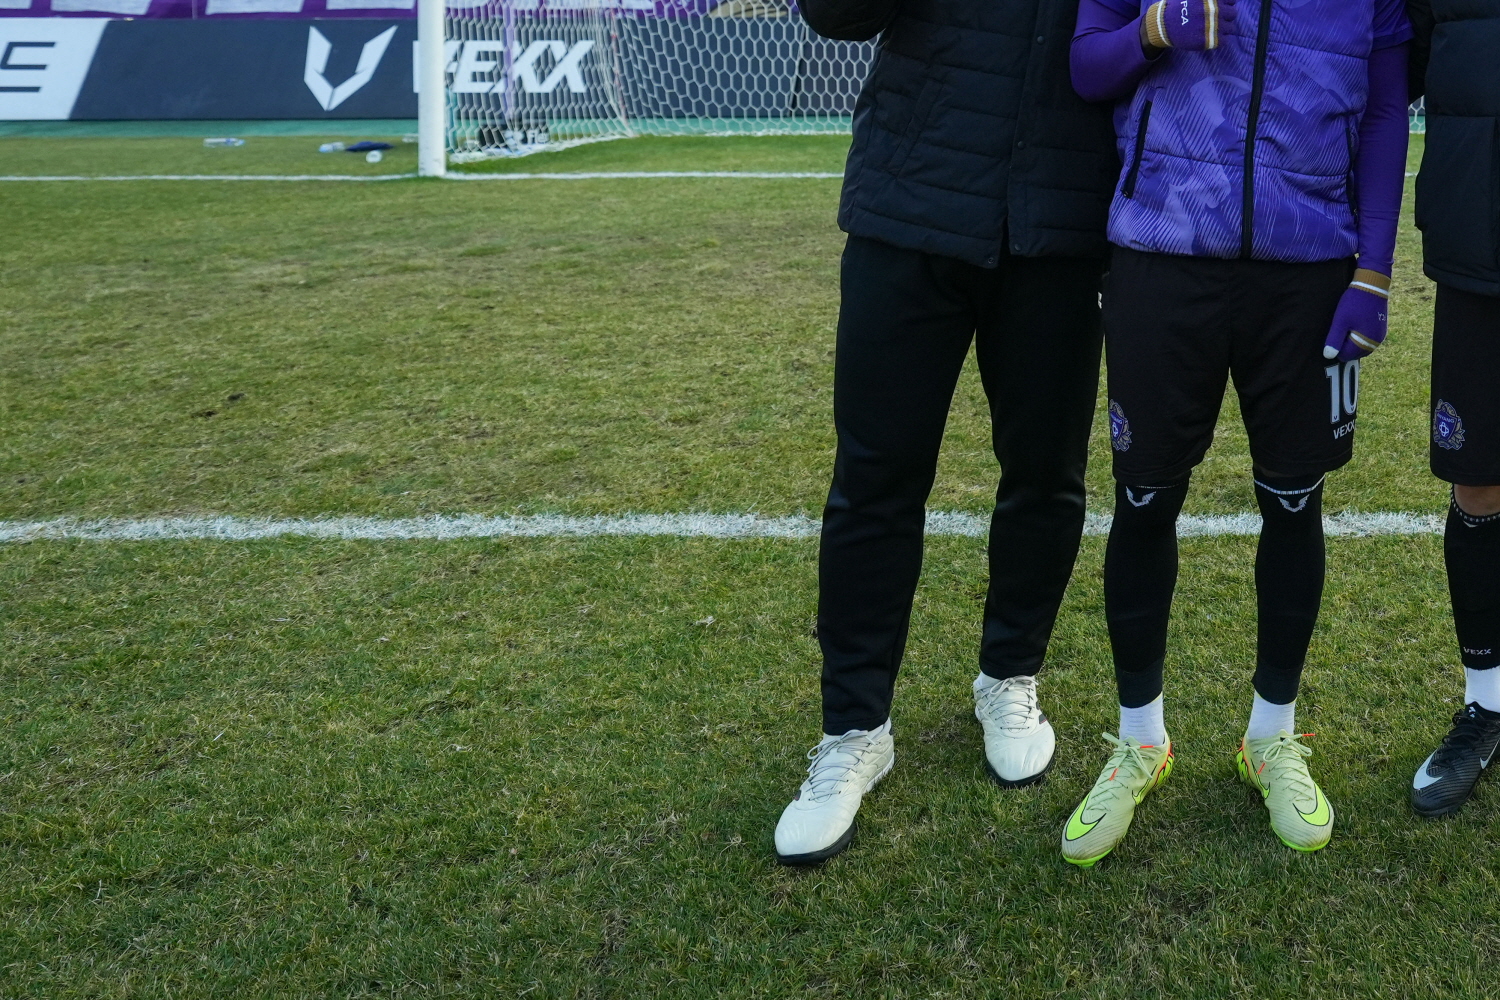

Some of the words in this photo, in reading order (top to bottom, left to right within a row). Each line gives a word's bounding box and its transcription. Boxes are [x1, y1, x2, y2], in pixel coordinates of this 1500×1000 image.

[1180, 0, 1189, 26] PCA
[1324, 359, 1360, 425] 10
[1463, 646, 1492, 656] VEXX
